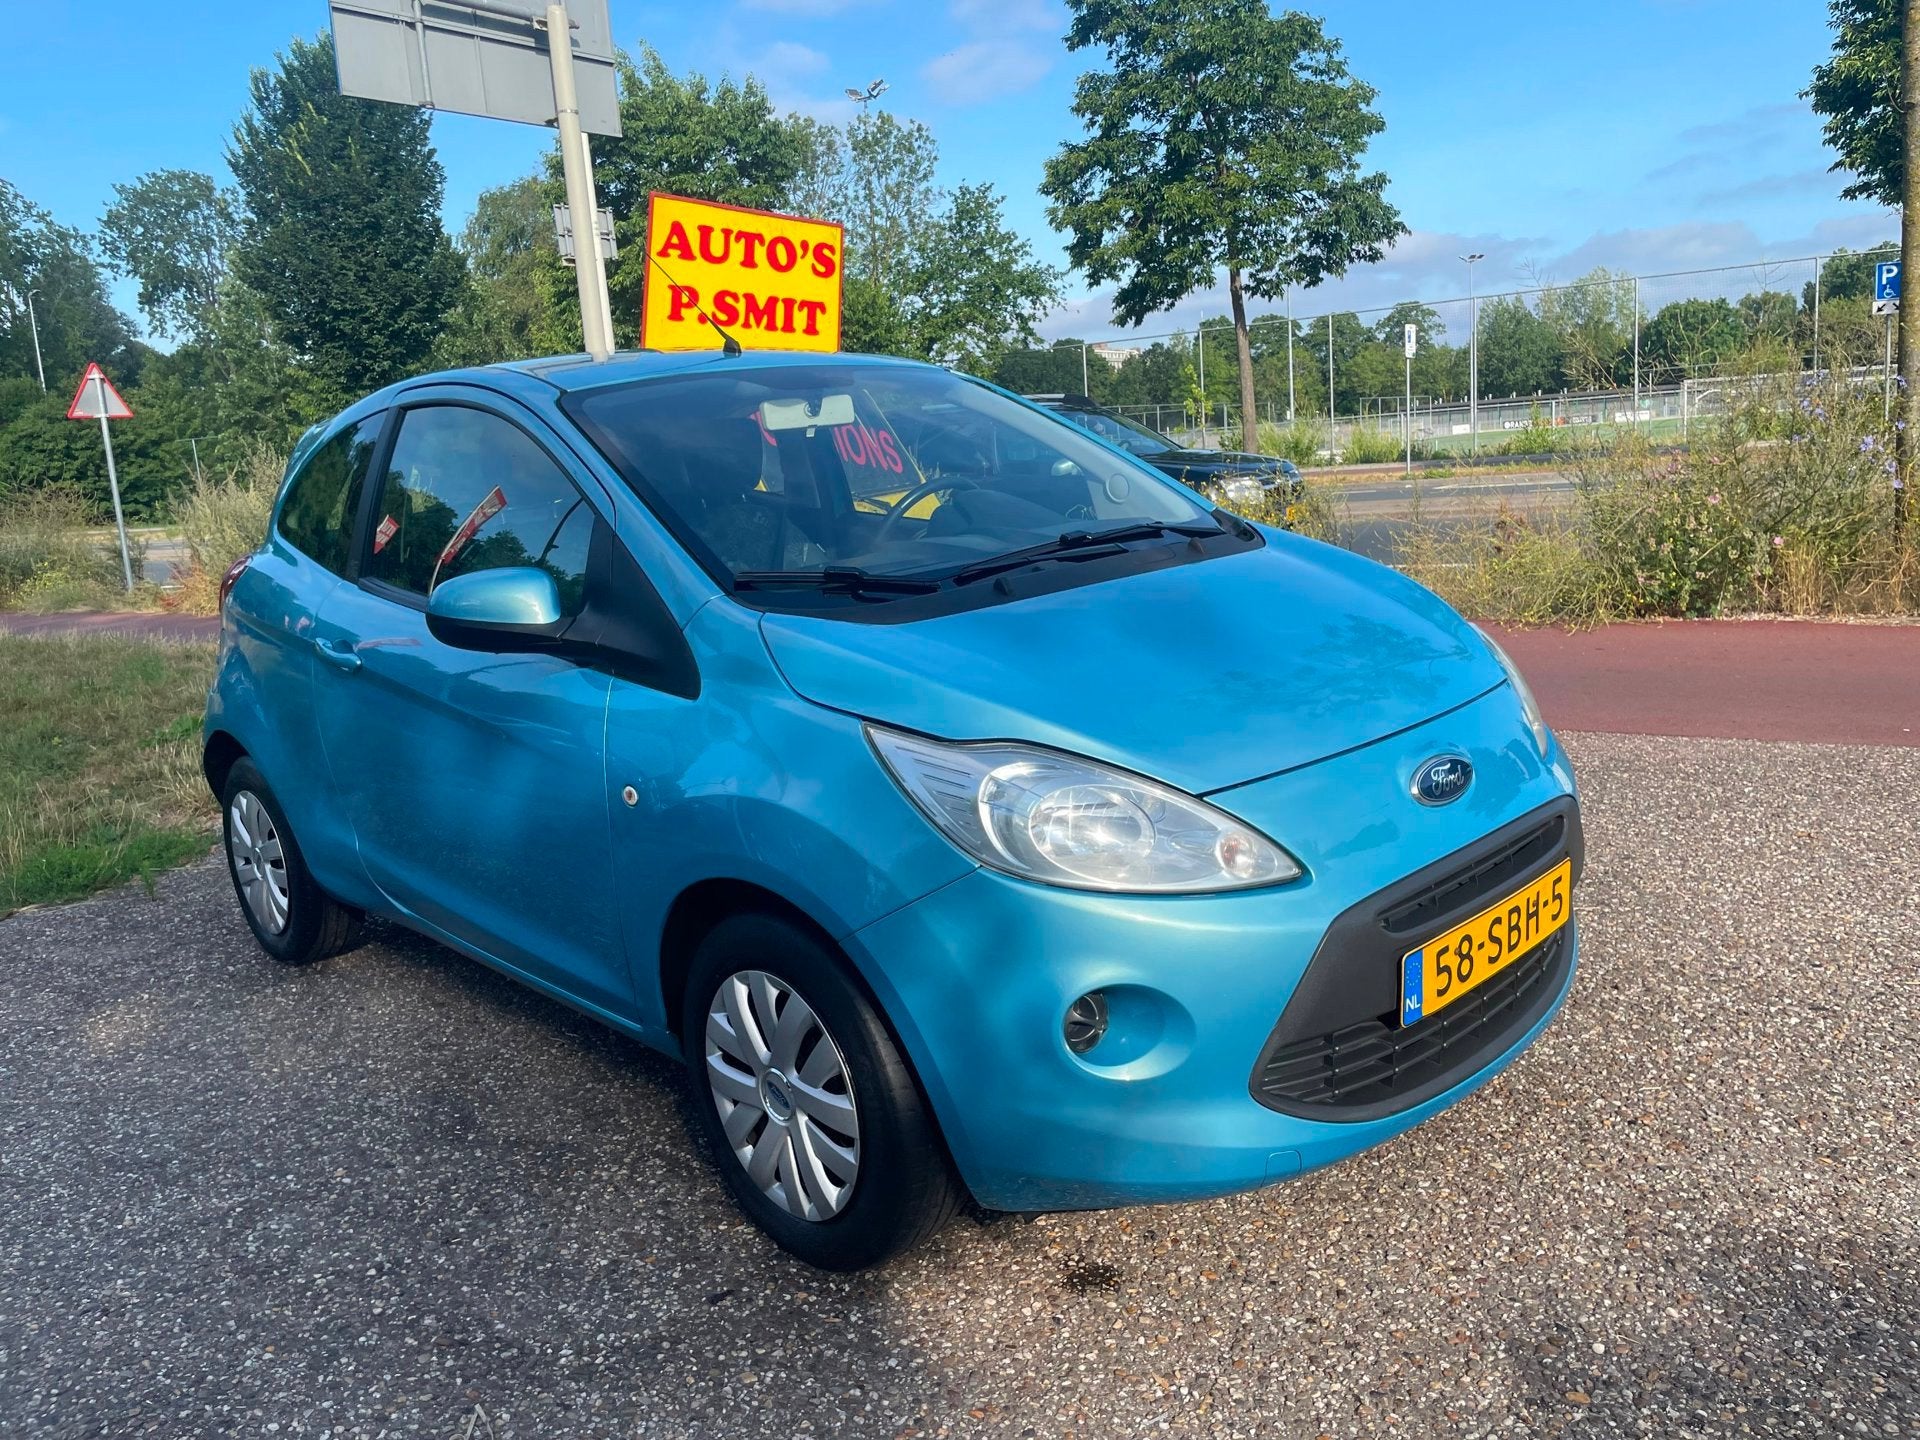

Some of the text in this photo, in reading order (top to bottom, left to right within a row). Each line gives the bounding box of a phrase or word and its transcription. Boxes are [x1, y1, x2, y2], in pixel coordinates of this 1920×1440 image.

[657, 221, 836, 278] AUTO'S
[1881, 265, 1898, 285] P
[1431, 762, 1465, 796] Ford
[1435, 875, 1563, 998] 58-SBH-5
[1405, 994, 1421, 1013] NL
